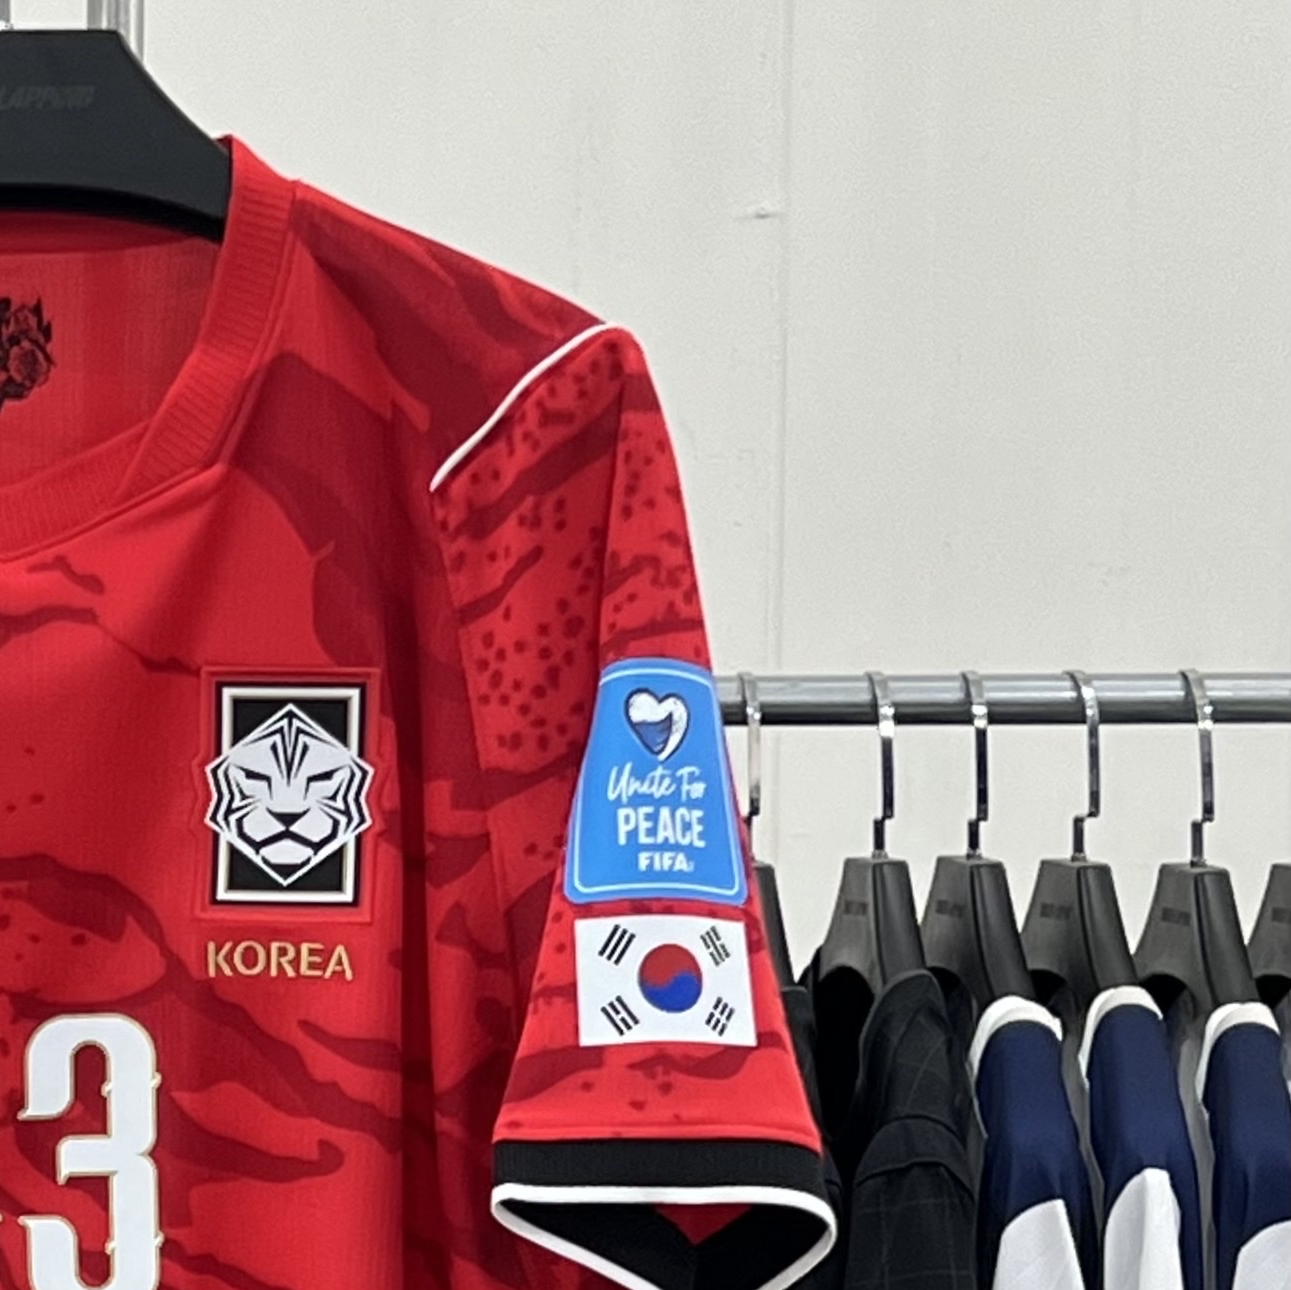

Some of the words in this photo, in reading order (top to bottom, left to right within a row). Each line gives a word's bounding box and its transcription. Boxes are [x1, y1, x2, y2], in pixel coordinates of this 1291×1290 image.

[606, 761, 676, 804] Unite
[617, 806, 707, 848] PEACE
[637, 851, 688, 872] FIFA
[207, 940, 353, 982] KOREA
